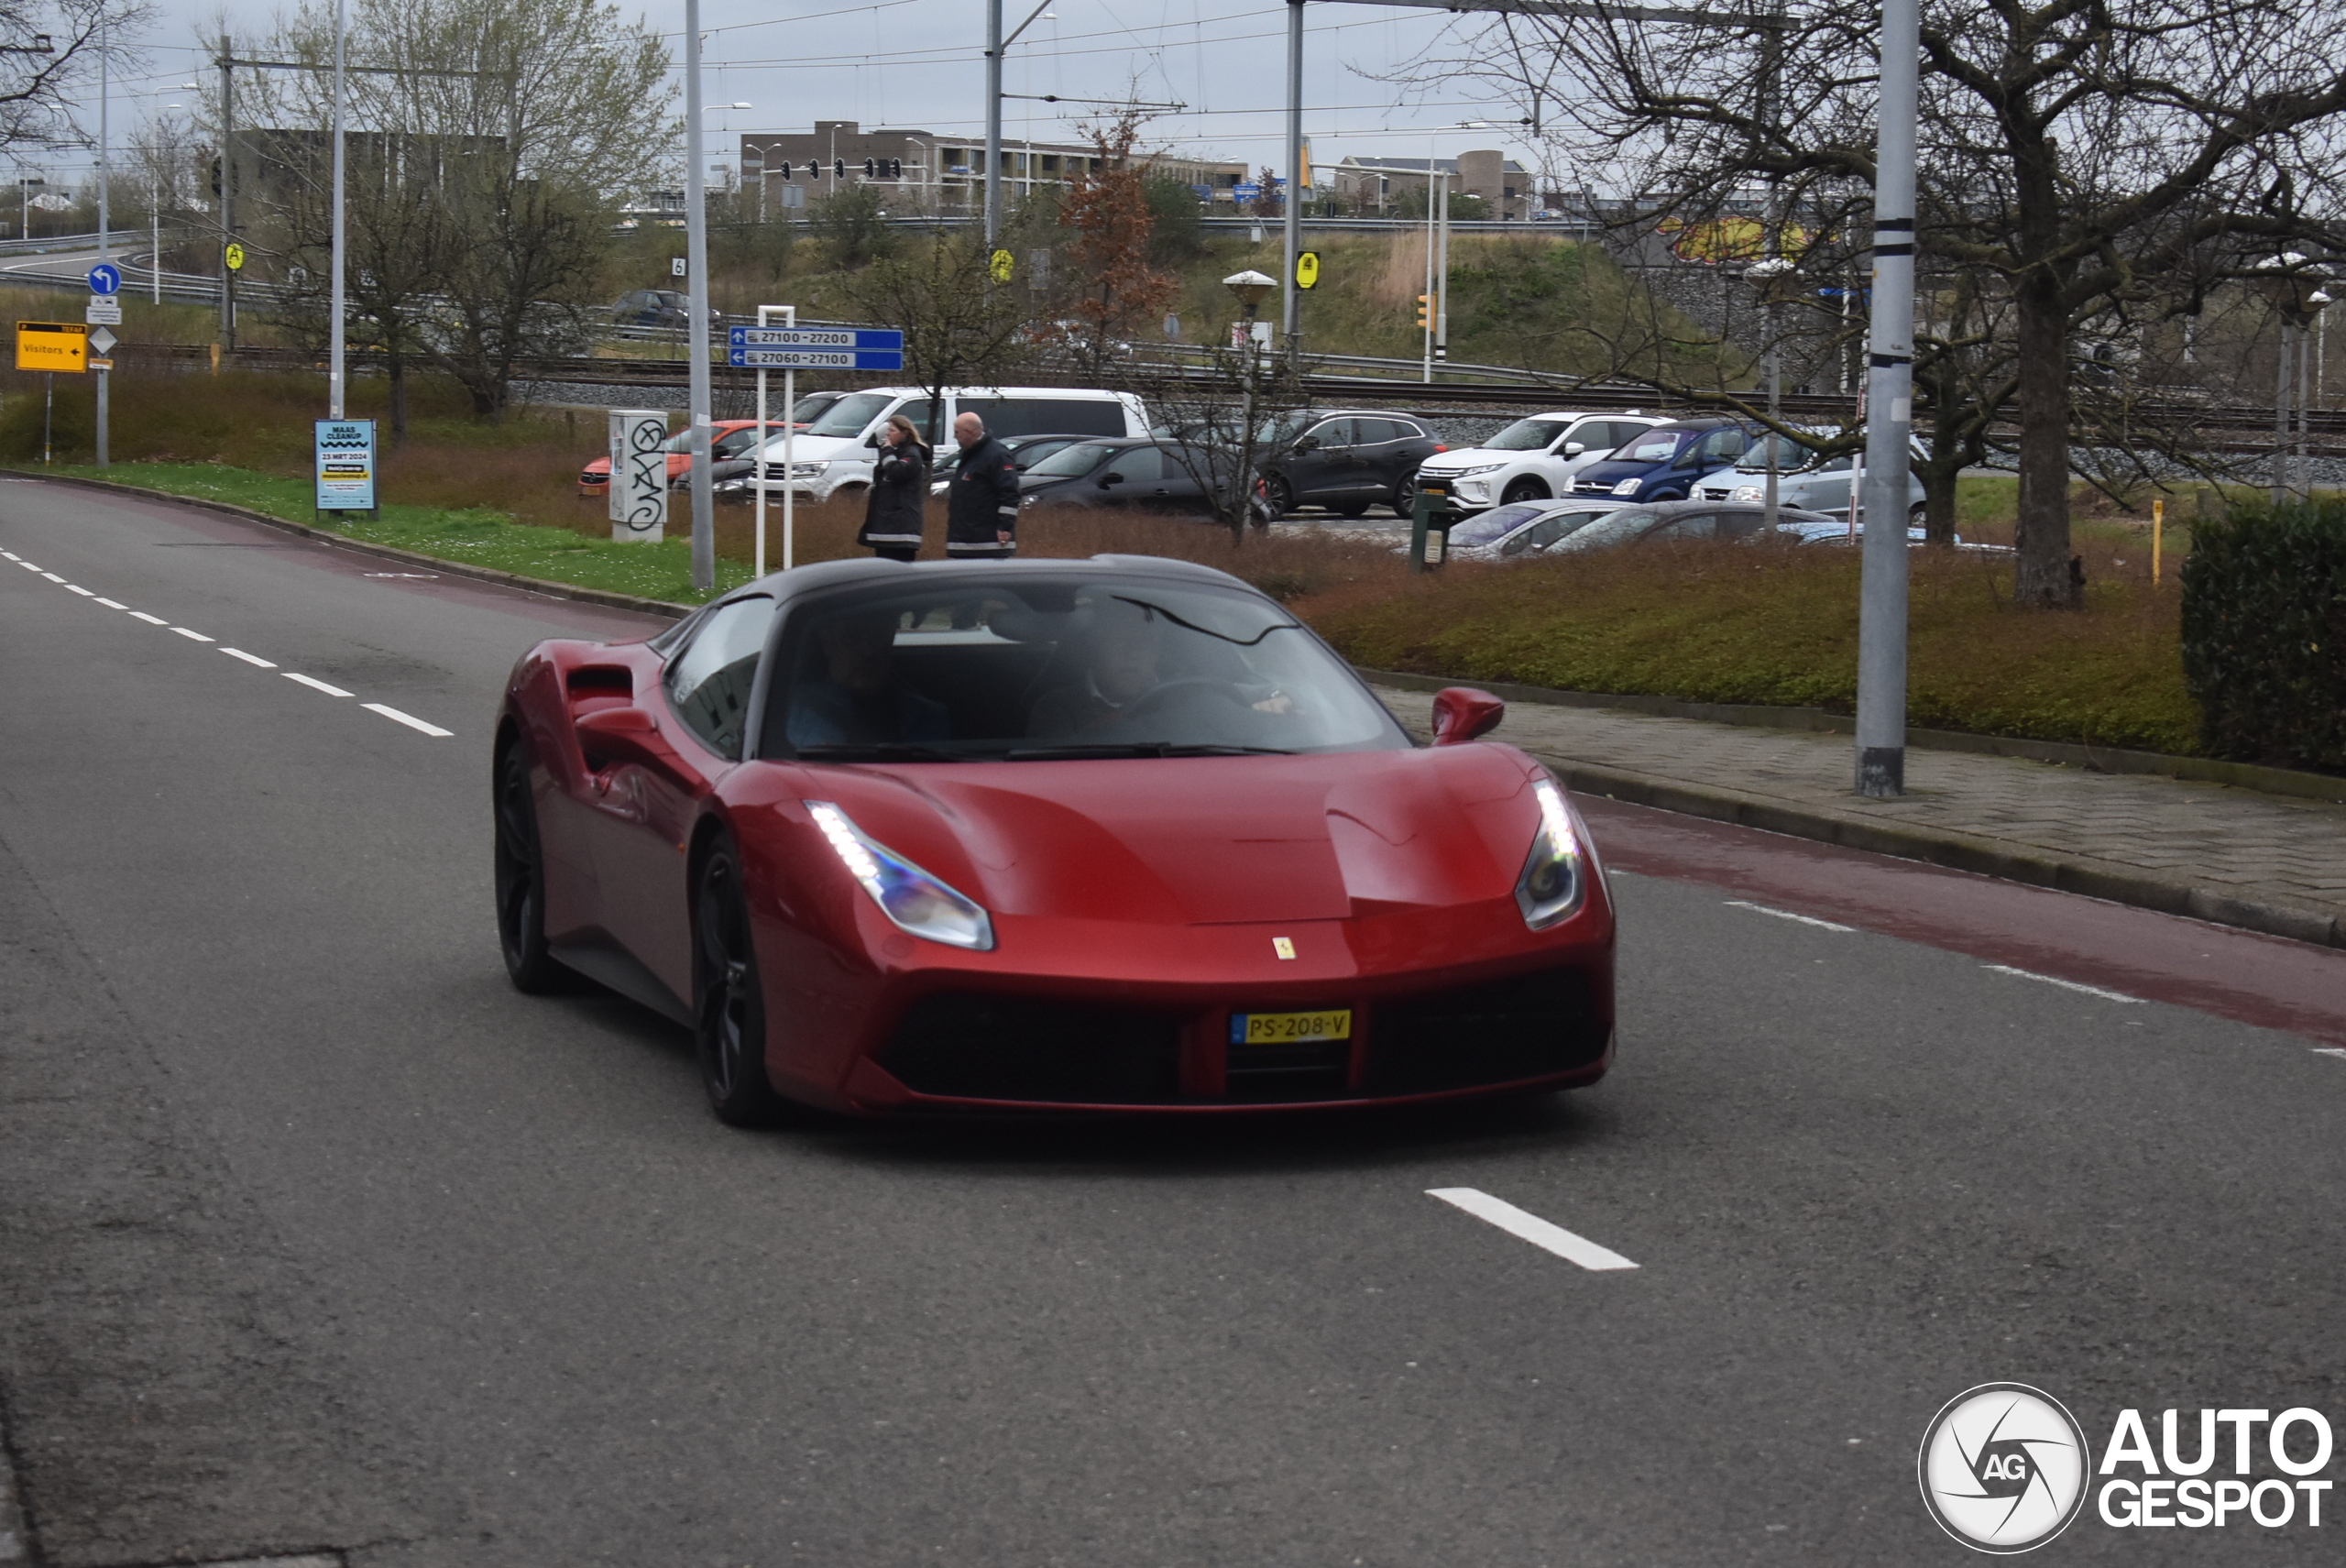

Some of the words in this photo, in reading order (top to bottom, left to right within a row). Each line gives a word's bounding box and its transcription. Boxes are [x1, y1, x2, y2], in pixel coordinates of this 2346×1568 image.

[229, 248, 240, 260] A
[675, 260, 682, 274] 6
[24, 345, 63, 354] Visitors
[1249, 1014, 1344, 1037] PS-208-V
